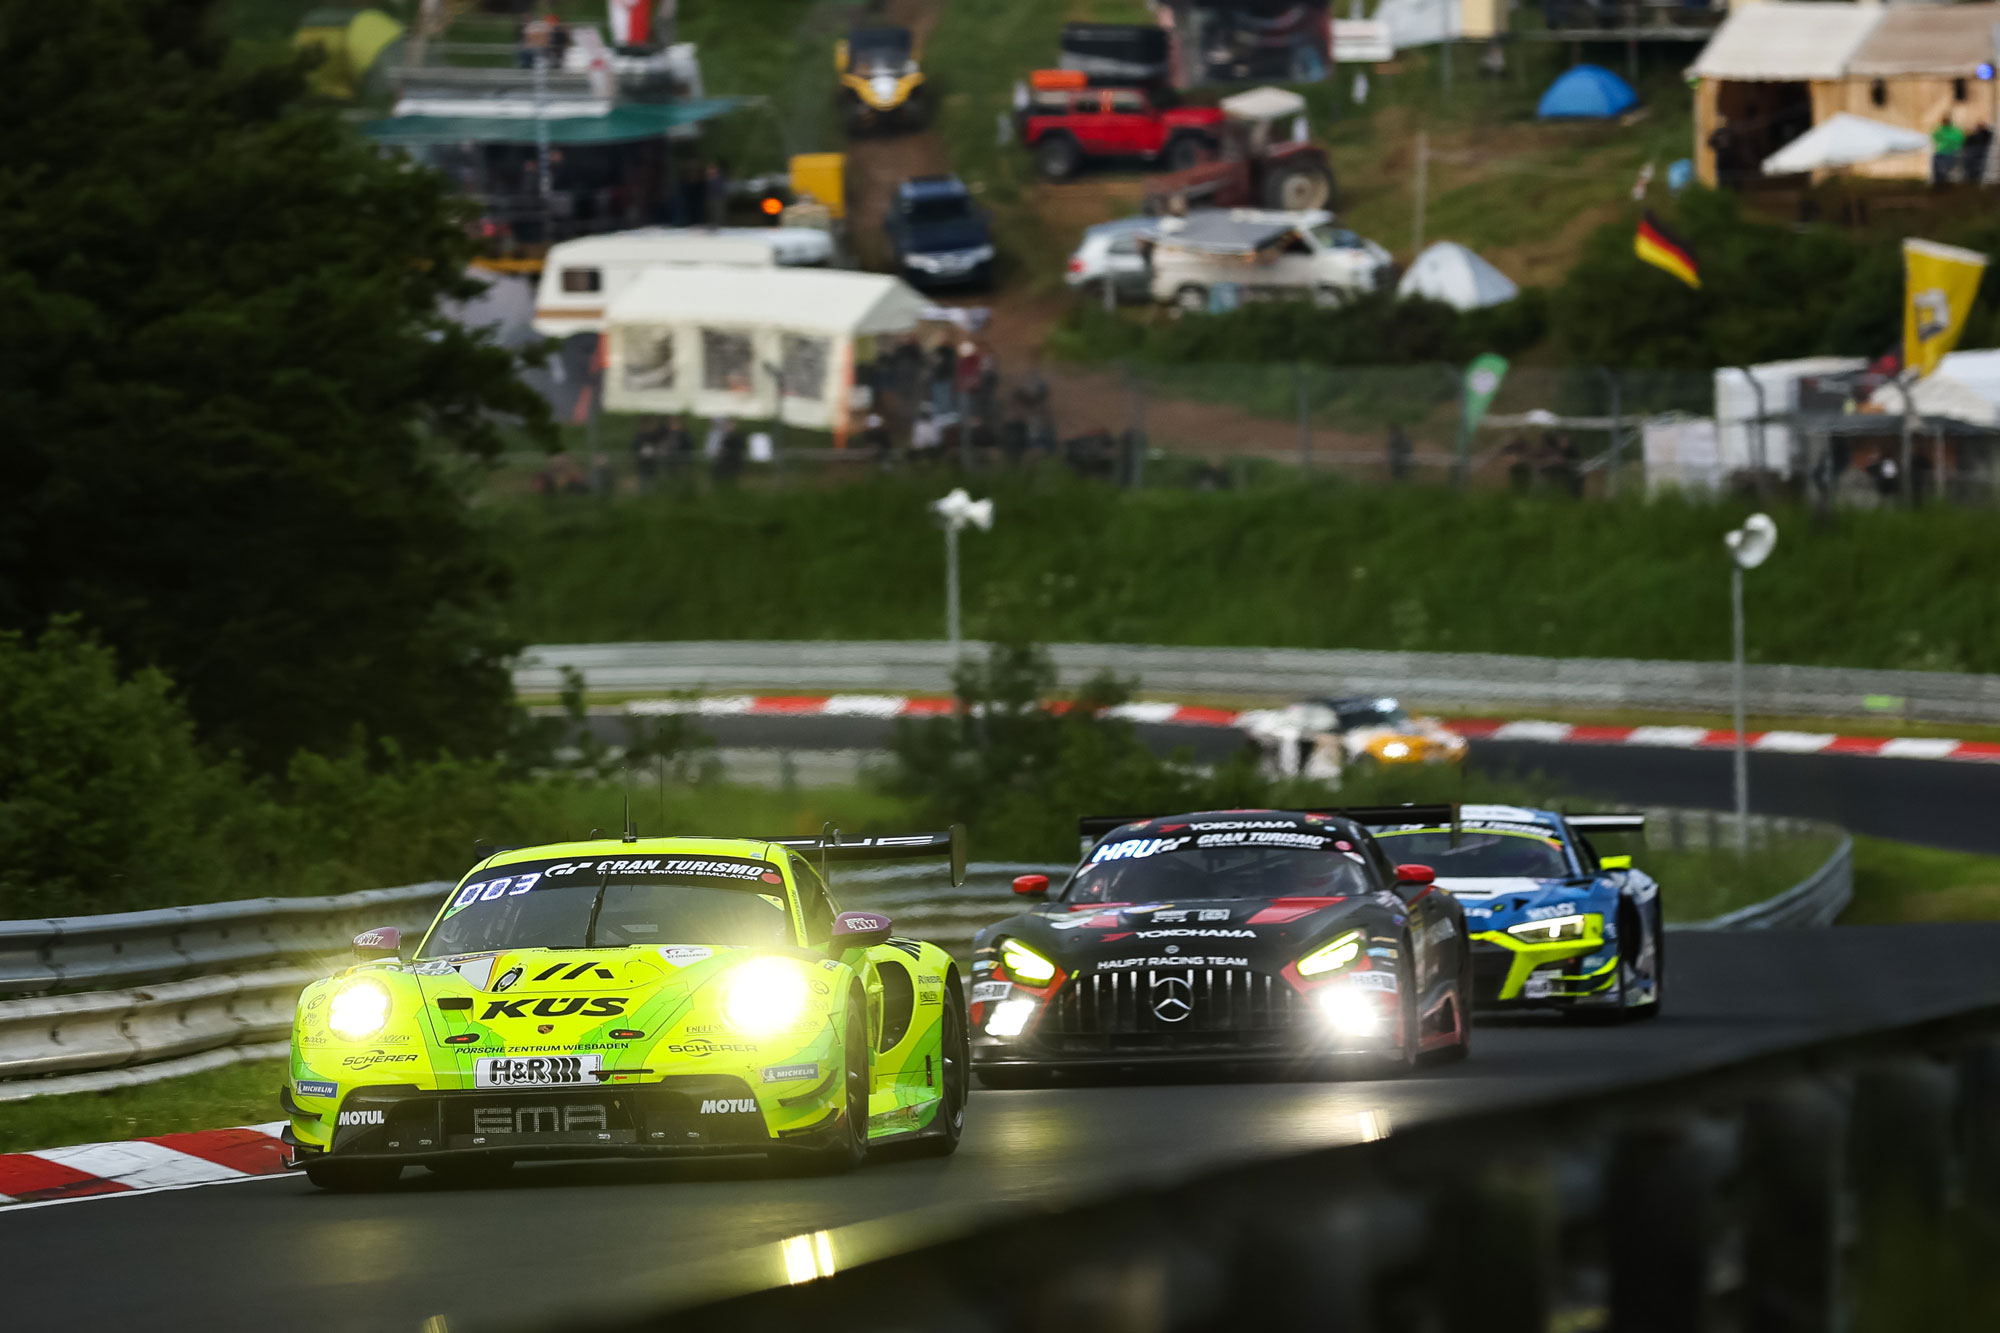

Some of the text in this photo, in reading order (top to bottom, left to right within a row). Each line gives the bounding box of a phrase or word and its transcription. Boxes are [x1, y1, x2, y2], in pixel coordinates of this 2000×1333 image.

[1189, 821, 1297, 831] YOKOHAMA
[1197, 833, 1248, 845] GRAN
[1249, 832, 1324, 845] TURISMO
[597, 860, 661, 871] GRAN
[664, 860, 765, 877] TURISMO
[695, 871, 758, 881] SIMULATOR
[452, 872, 542, 908] 003
[1136, 929, 1257, 939] YOKOHAMA
[1097, 956, 1249, 970] HAUPT RACING TEAM
[480, 997, 630, 1020] KÜS
[455, 1042, 630, 1055] PORSCHE ZENTRUM WIESBADEN
[668, 1043, 759, 1053] SCHERER
[341, 1053, 419, 1067] SCHERER
[489, 1058, 550, 1085] H&R
[776, 1067, 816, 1078] MICHELIN
[302, 1084, 334, 1094] MICHELIN
[700, 1098, 758, 1114] MOTUL
[338, 1109, 385, 1126] MOTUL
